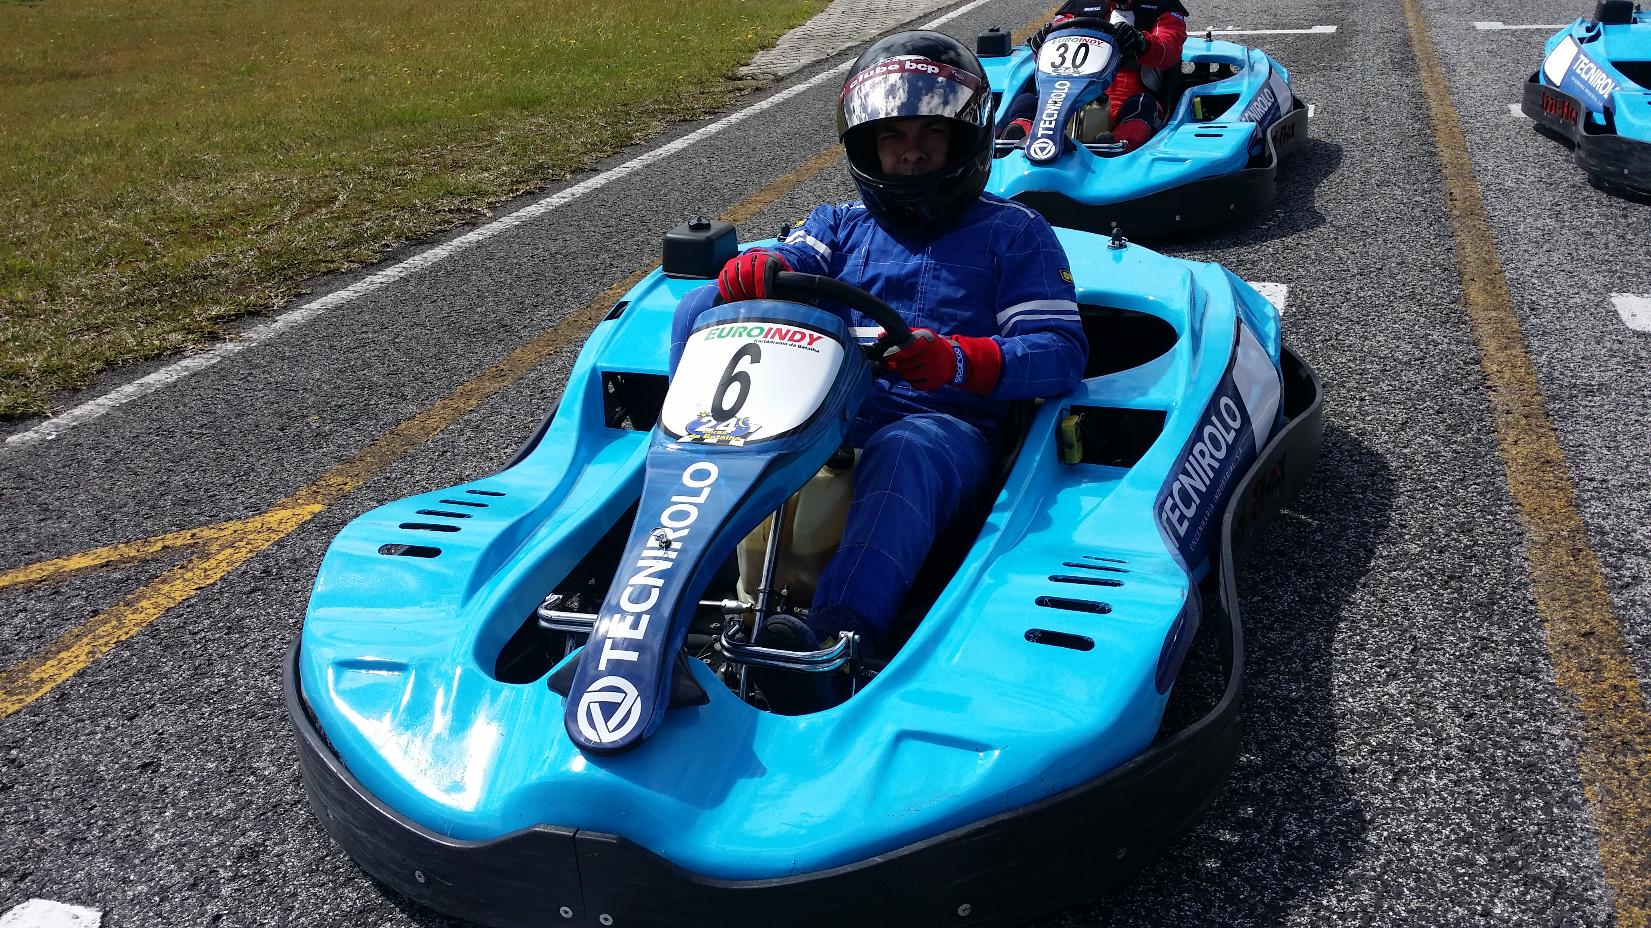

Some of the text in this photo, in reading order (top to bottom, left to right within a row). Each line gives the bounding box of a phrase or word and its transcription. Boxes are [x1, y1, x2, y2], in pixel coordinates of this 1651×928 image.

[1051, 37, 1103, 46] EUROINDY
[1051, 43, 1089, 68] 30
[849, 60, 940, 89] clube bcp
[1037, 80, 1070, 137] TECNIROLO
[704, 325, 824, 346] EUROINDY
[710, 342, 762, 423] 6
[694, 416, 738, 435] 24
[1161, 396, 1242, 548] TECNIROLO
[598, 461, 719, 671] TECNIROLO
